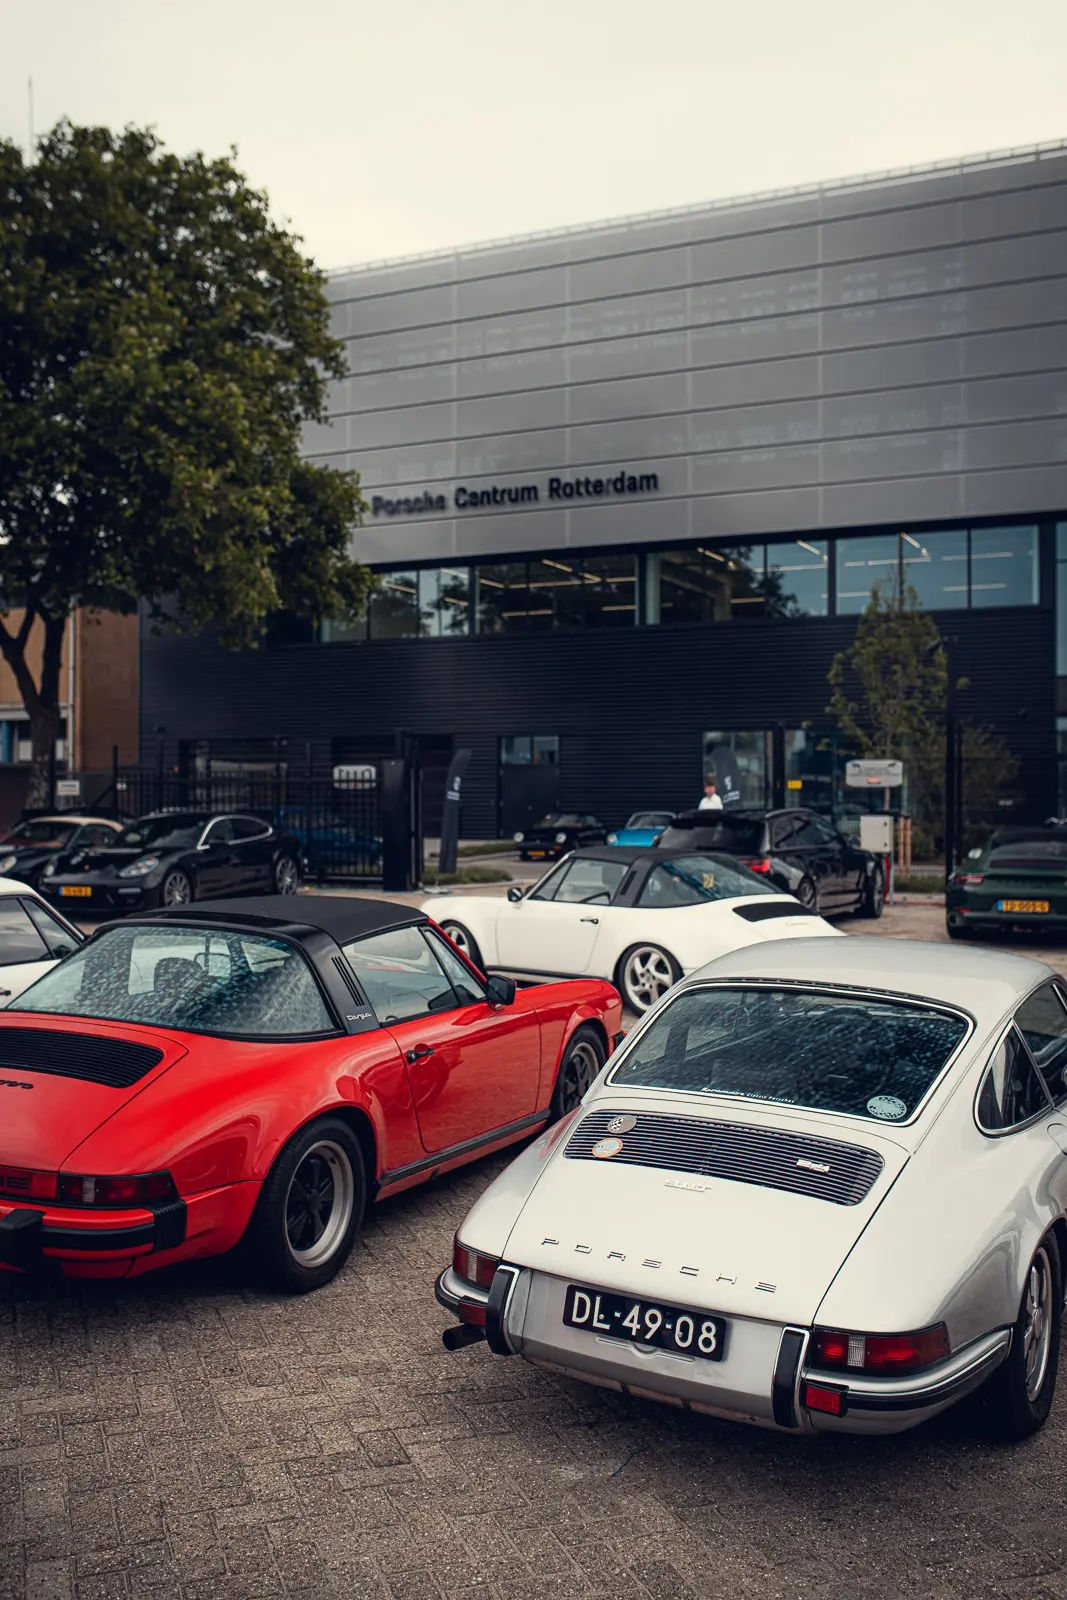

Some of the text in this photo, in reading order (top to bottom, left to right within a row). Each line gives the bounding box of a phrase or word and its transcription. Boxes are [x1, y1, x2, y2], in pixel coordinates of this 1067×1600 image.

[371, 471, 659, 517] Porsche Centrum Rotterdam
[541, 1237, 777, 1294] PORSCHE
[571, 1290, 717, 1354] DL-49-08
